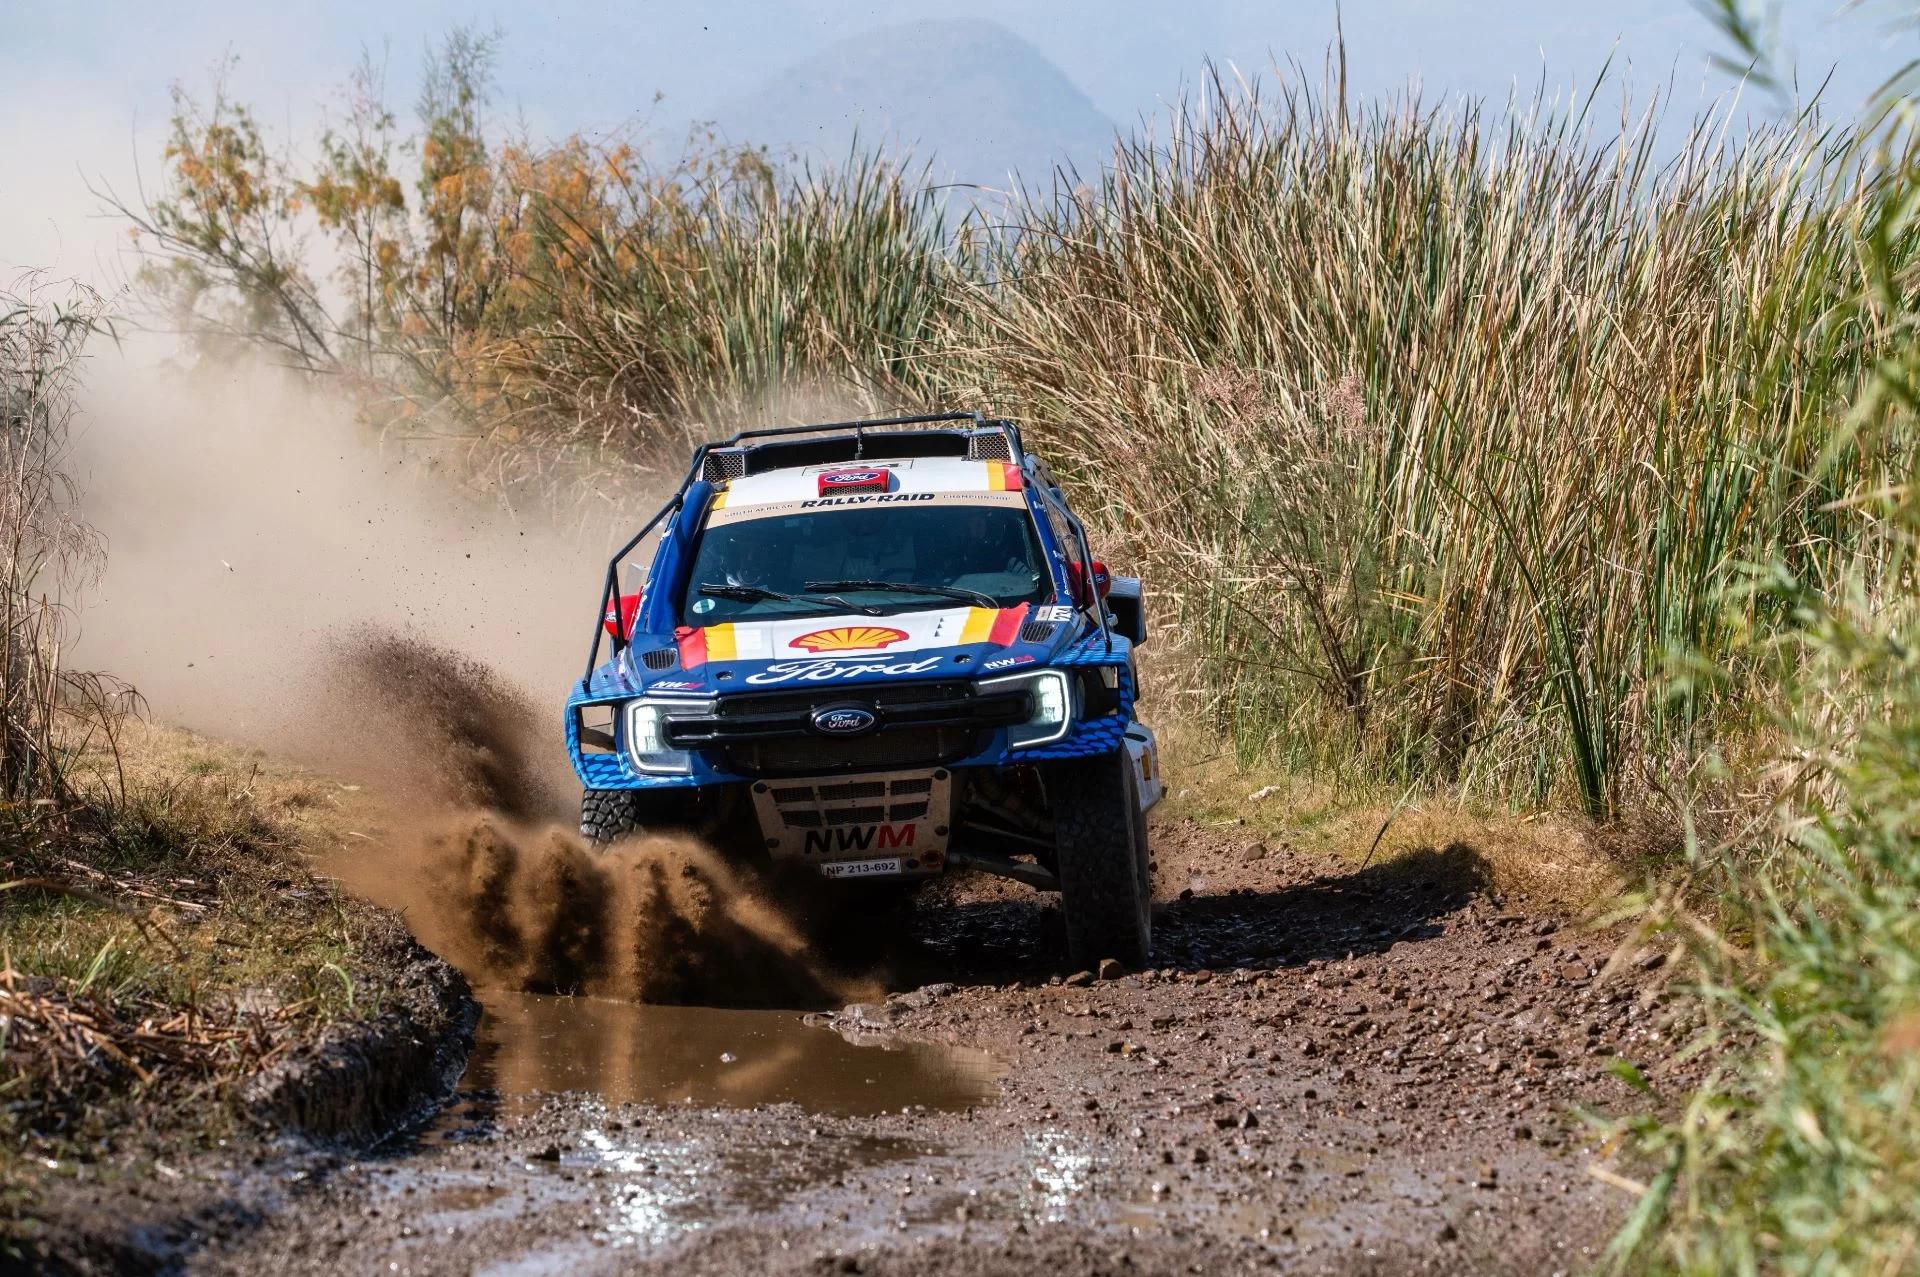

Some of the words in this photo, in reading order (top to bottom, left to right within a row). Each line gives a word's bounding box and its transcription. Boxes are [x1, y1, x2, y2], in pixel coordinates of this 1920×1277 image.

[755, 503, 793, 513] AFRICAN
[800, 493, 935, 508] RALLY-RAID
[745, 655, 944, 685] Ford
[828, 714, 861, 728] Ford
[805, 823, 916, 854] NWM
[826, 865, 845, 876] NP
[847, 861, 896, 875] 213-692
